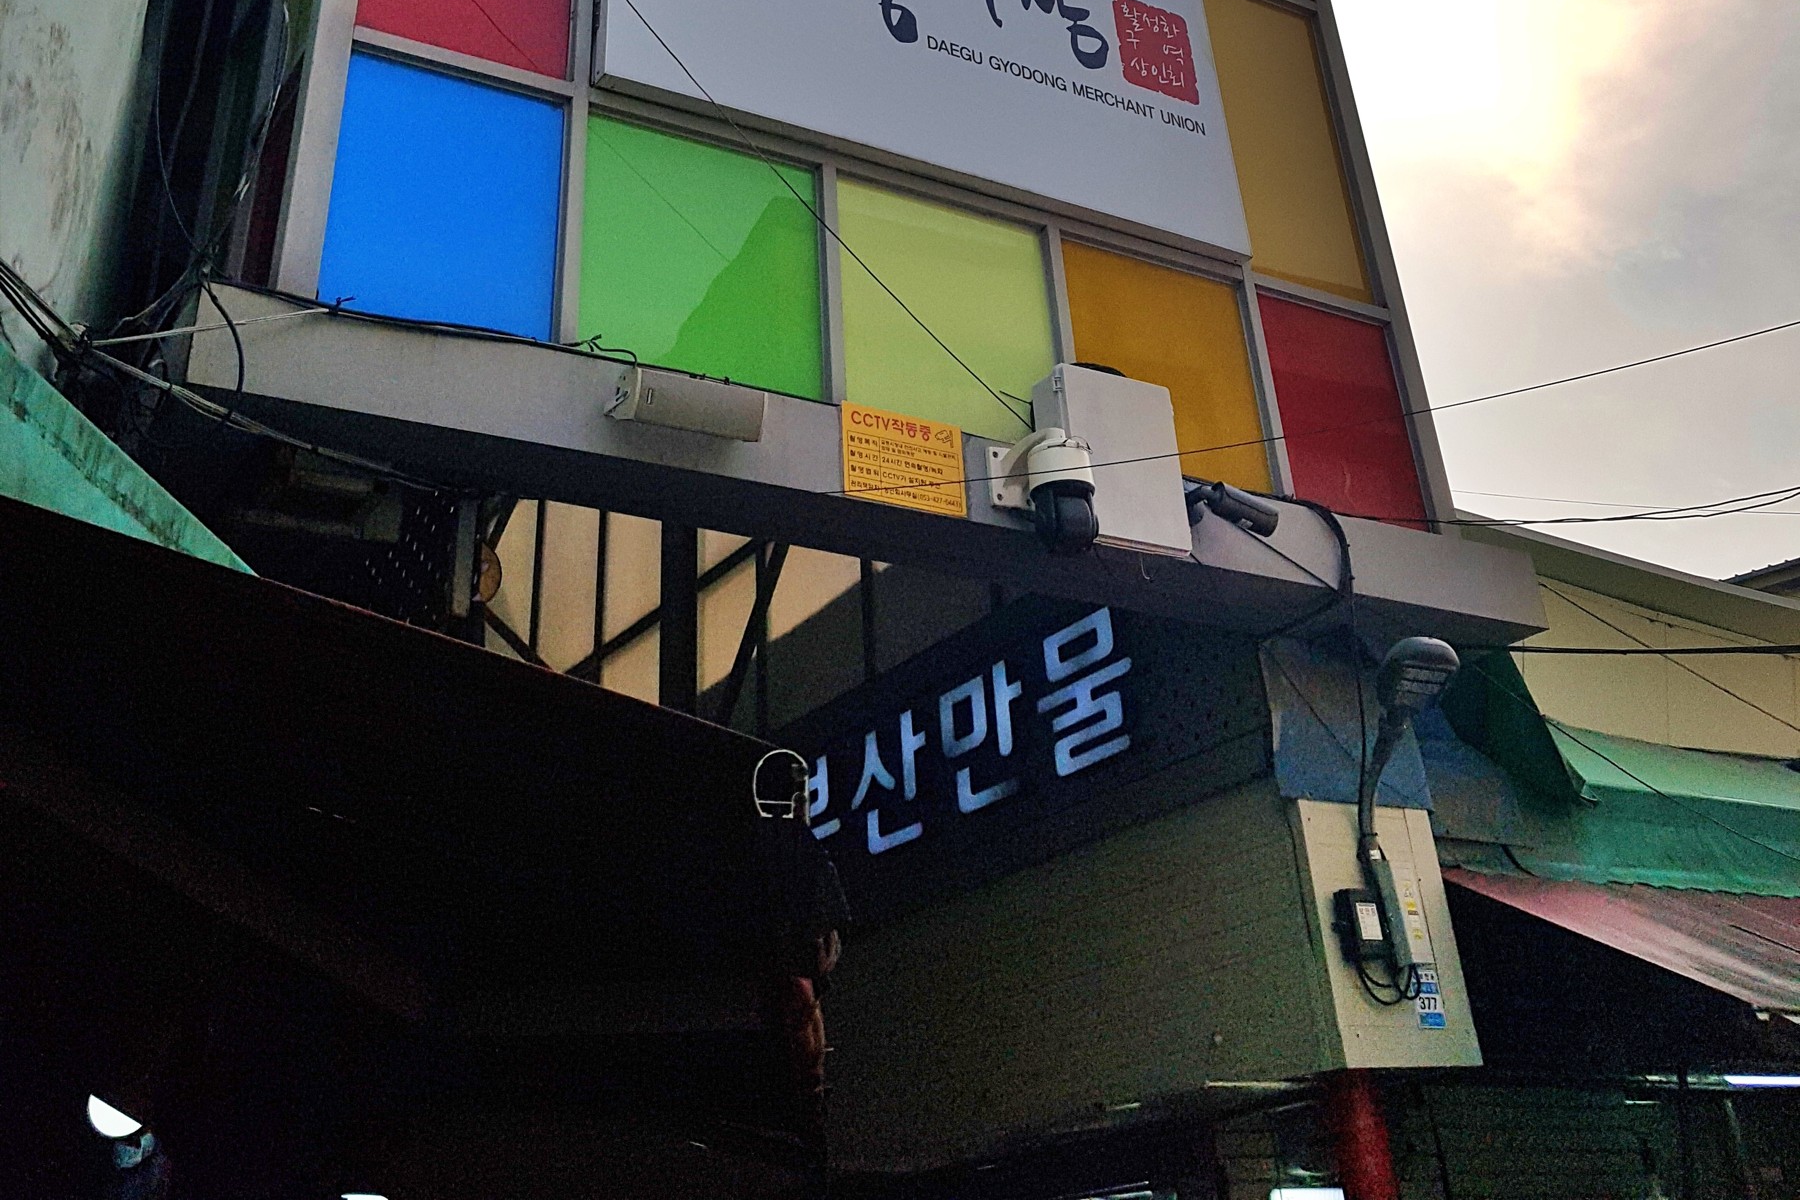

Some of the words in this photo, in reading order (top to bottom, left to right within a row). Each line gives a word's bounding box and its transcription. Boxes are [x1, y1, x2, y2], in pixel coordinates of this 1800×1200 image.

[1120, 1, 1181, 39] 활성화
[926, 34, 984, 65] DAEGU
[988, 54, 1068, 92] GYODONG
[1072, 80, 1155, 119] MERCHANT
[1159, 109, 1207, 136] UNION
[1130, 57, 1185, 88] 상인회
[881, 456, 903, 467] 24시간
[1418, 996, 1437, 1010] 377
